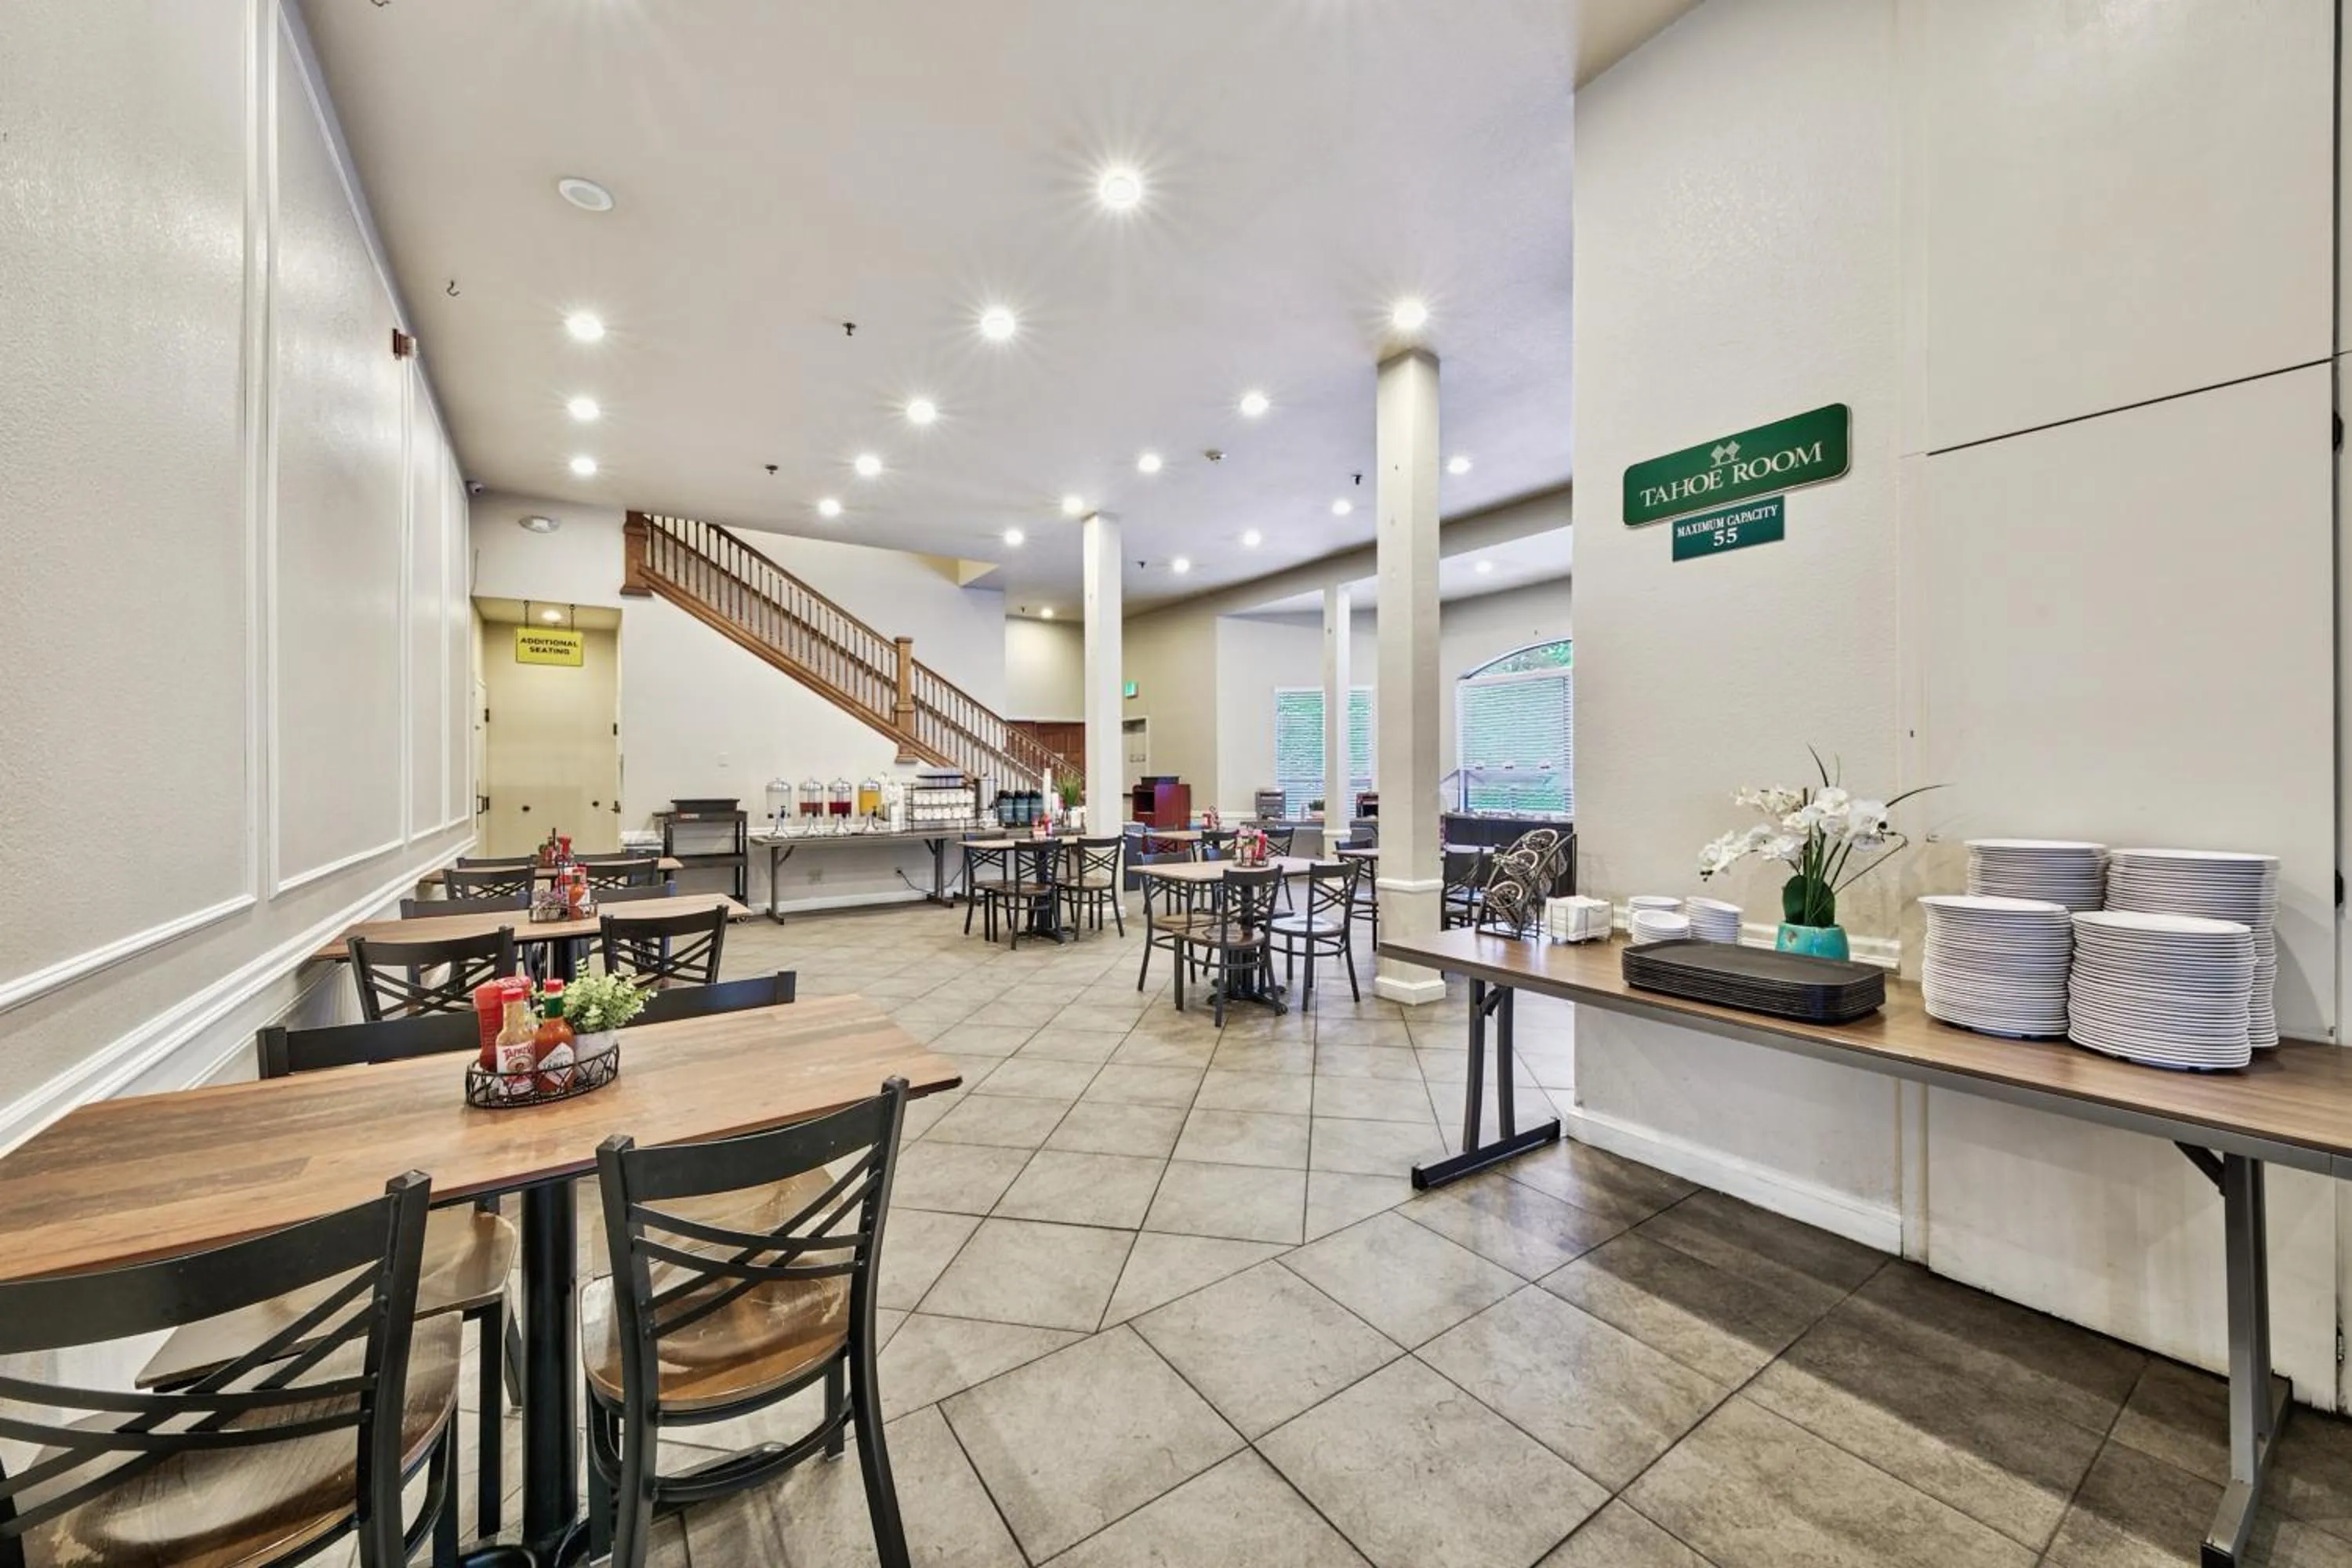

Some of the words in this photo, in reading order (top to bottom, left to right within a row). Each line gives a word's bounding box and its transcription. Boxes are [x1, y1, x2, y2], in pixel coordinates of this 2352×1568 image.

[1640, 469, 1722, 506] TAHOE
[1732, 441, 1823, 484] ROOM
[1677, 517, 1725, 537] MAXIMUM
[1726, 504, 1779, 526] CAPACITY
[1712, 527, 1738, 546] 55
[520, 637, 579, 648] ADDITIONAL
[528, 646, 571, 655] SEATING
